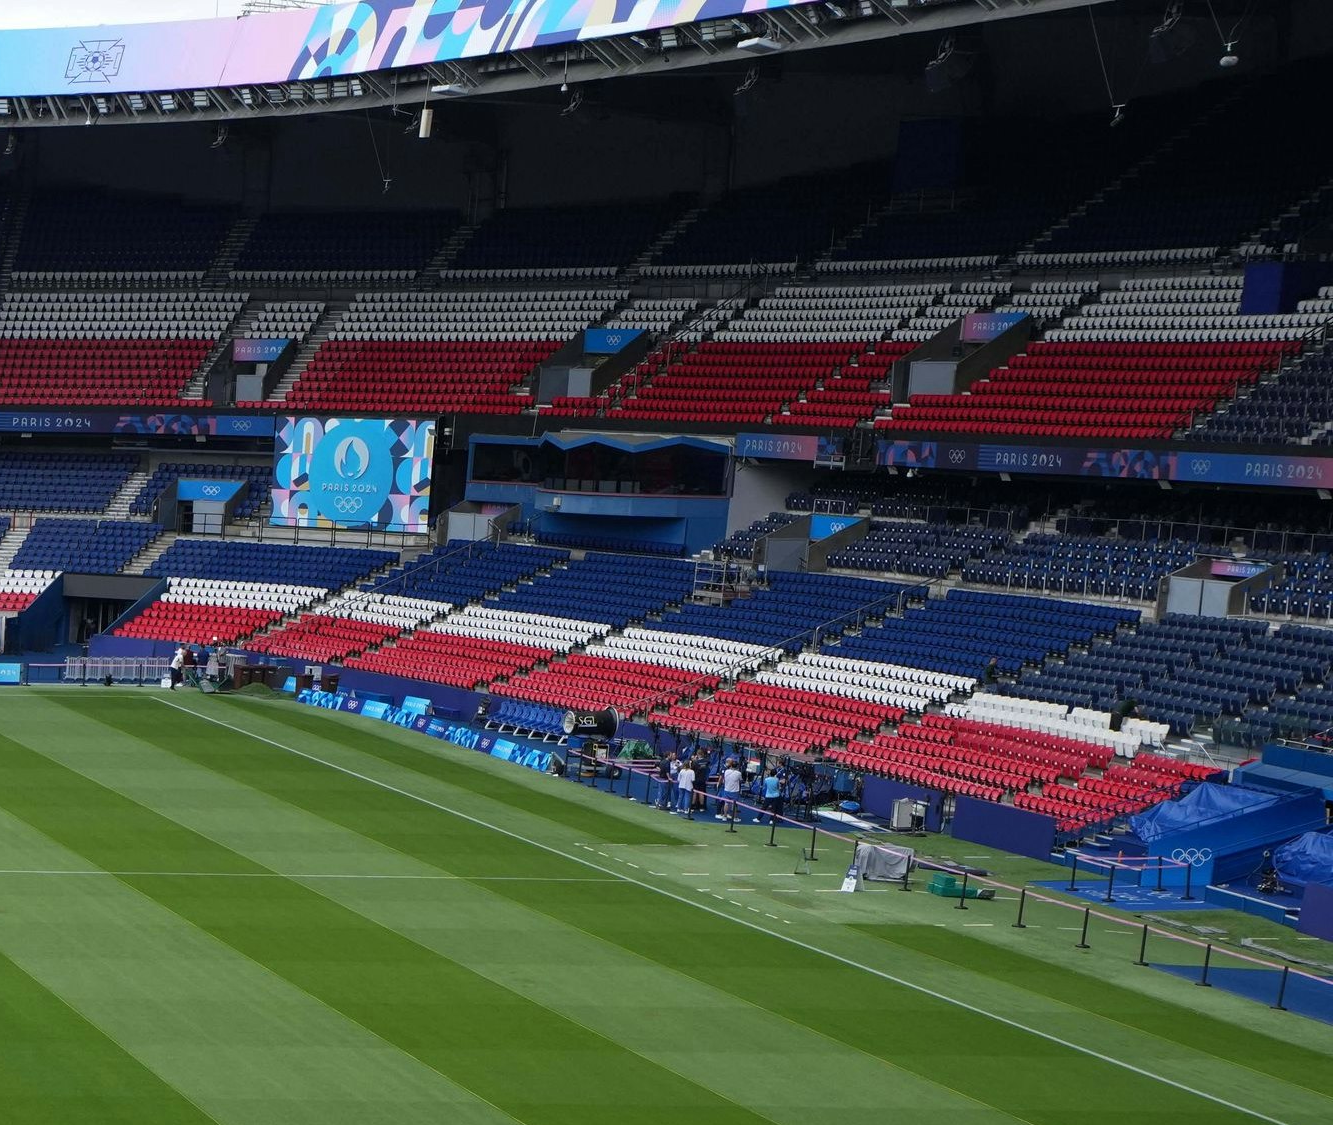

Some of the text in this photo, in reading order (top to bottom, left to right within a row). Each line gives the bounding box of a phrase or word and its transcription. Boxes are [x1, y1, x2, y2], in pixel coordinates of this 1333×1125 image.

[12, 418, 91, 427] PARIS 2024
[996, 452, 1062, 467] PARIS 2024
[1246, 463, 1323, 478] PARIS 2024
[322, 483, 377, 493] PARIS 2024
